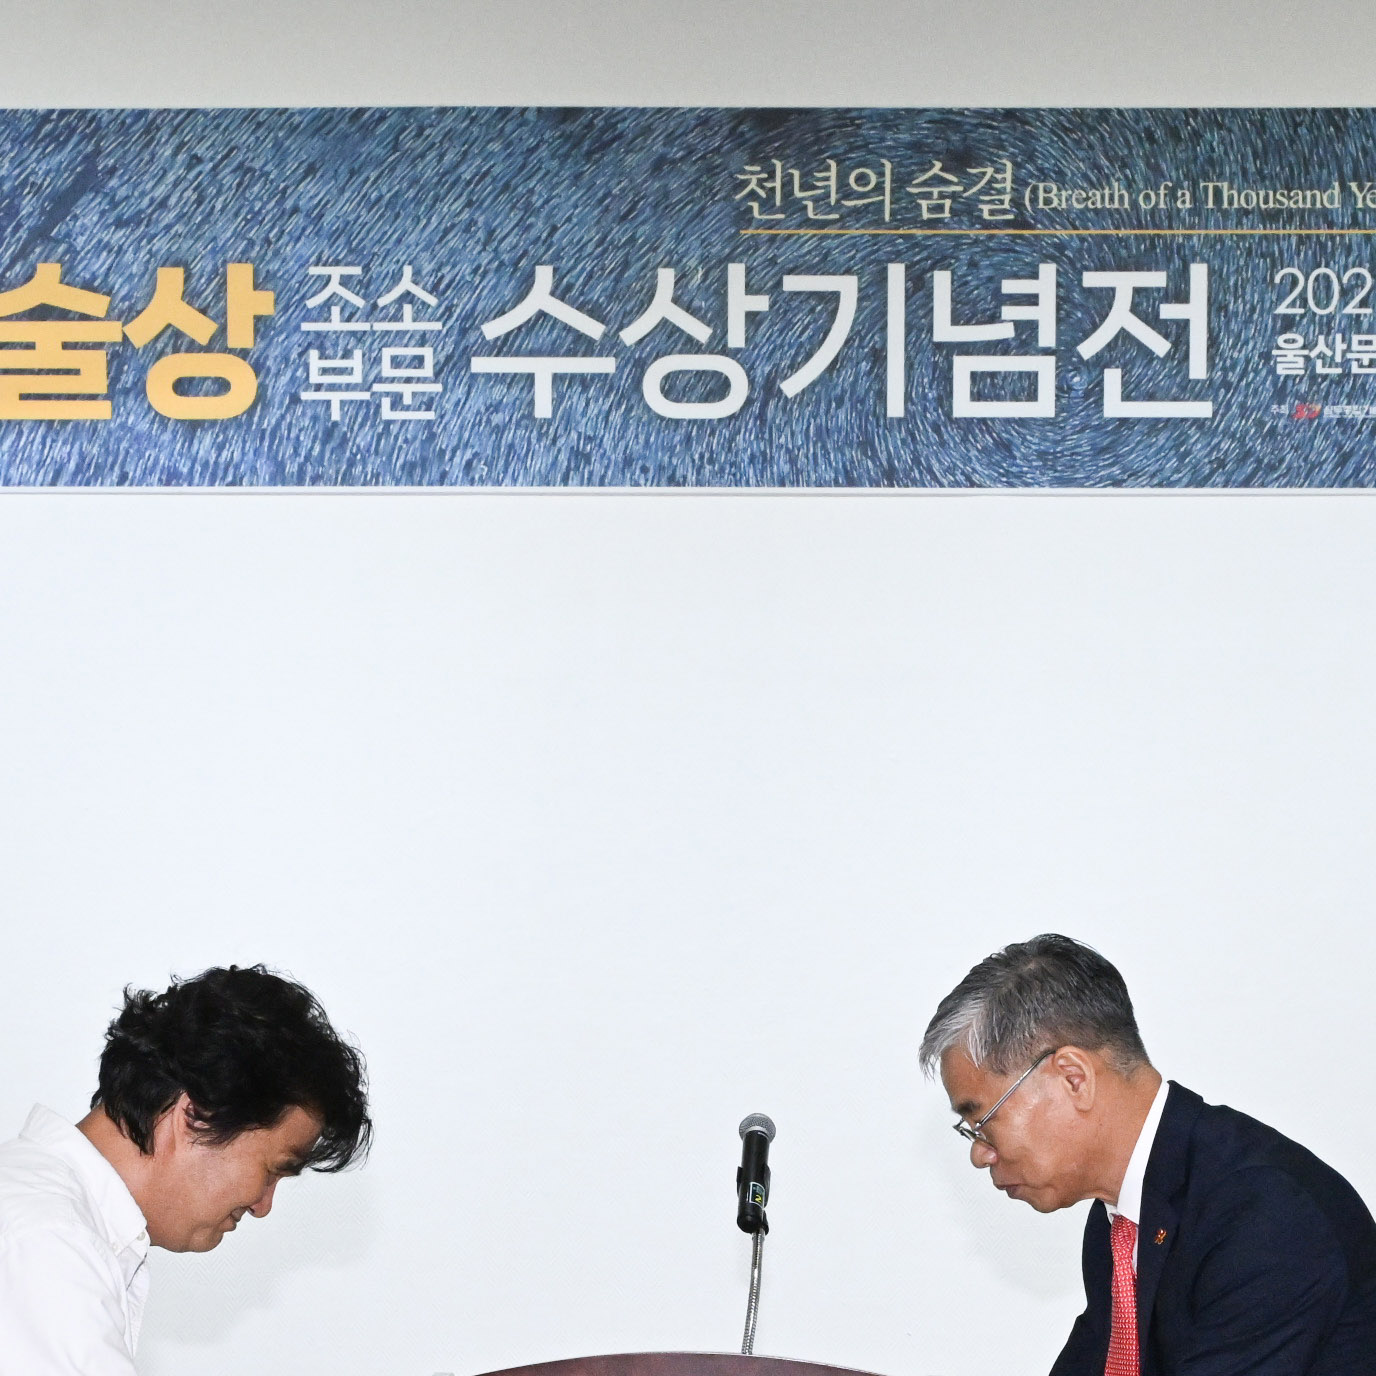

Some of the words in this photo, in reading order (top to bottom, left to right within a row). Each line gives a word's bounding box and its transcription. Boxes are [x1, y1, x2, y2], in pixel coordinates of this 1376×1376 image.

[735, 159, 892, 222] 천년의
[905, 159, 1015, 221] 숨결
[1024, 181, 1129, 214] (Breath
[1139, 181, 1173, 209] of
[1176, 189, 1193, 209] a
[1200, 181, 1341, 209] Thousand
[300, 263, 444, 333] 조소
[470, 262, 1214, 419] 수상기념전
[300, 349, 443, 420] 부문
